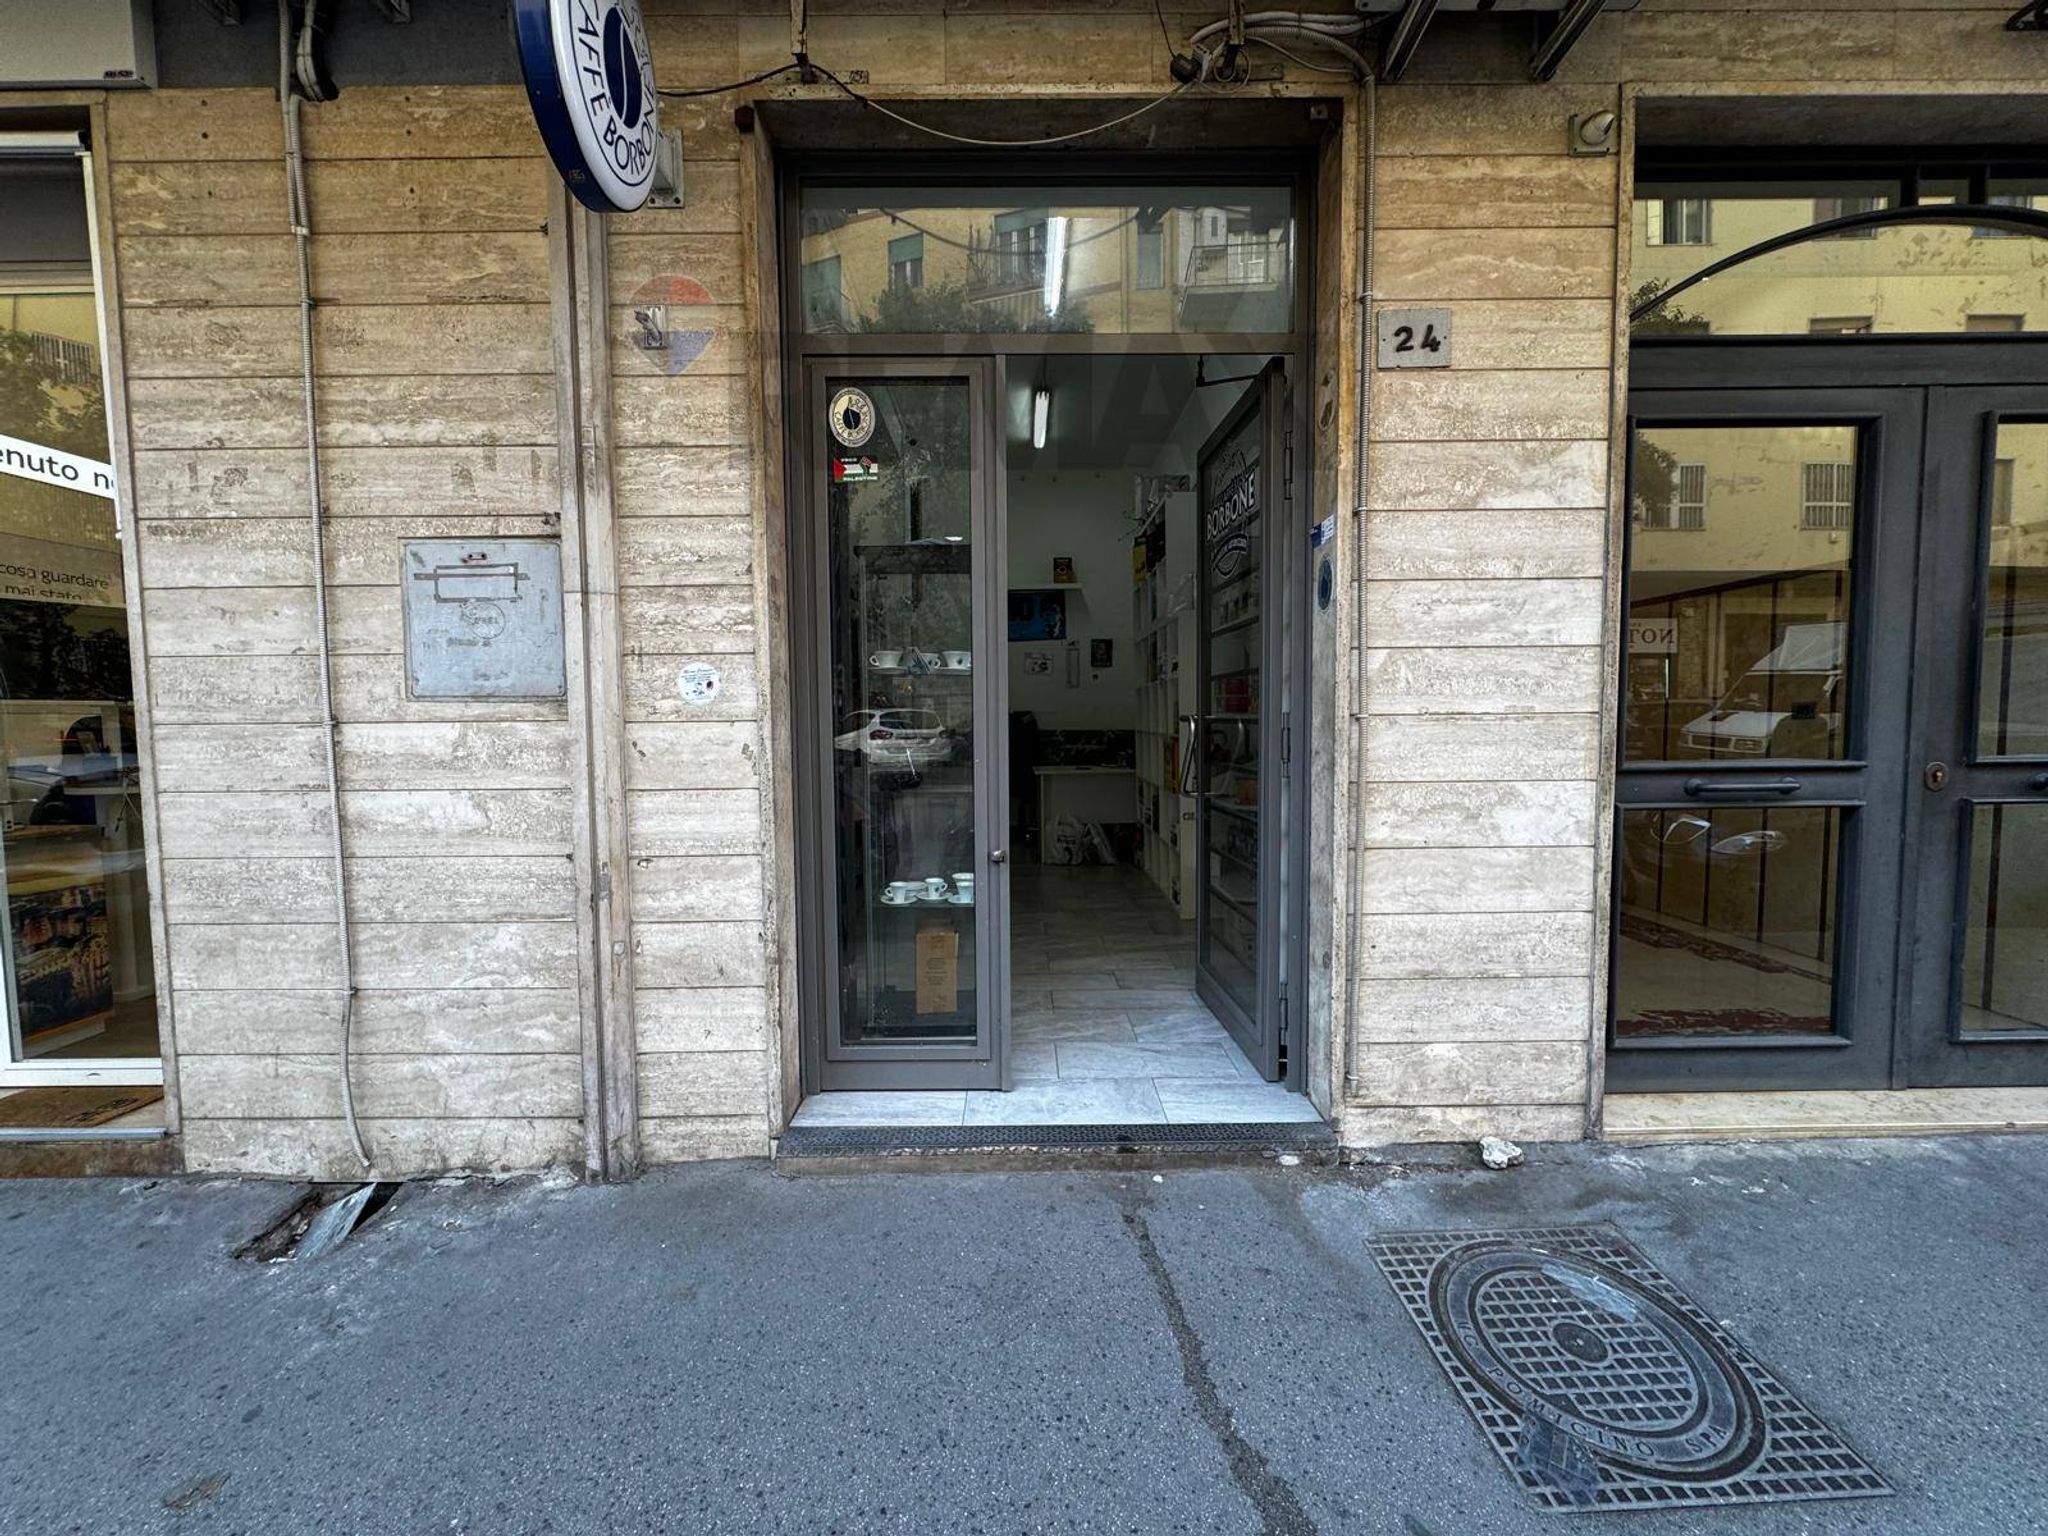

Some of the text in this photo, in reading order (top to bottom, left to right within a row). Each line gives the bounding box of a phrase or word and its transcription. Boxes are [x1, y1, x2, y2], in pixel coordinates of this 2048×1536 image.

[1394, 324, 1441, 352] 24
[0, 447, 114, 490] nuto n
